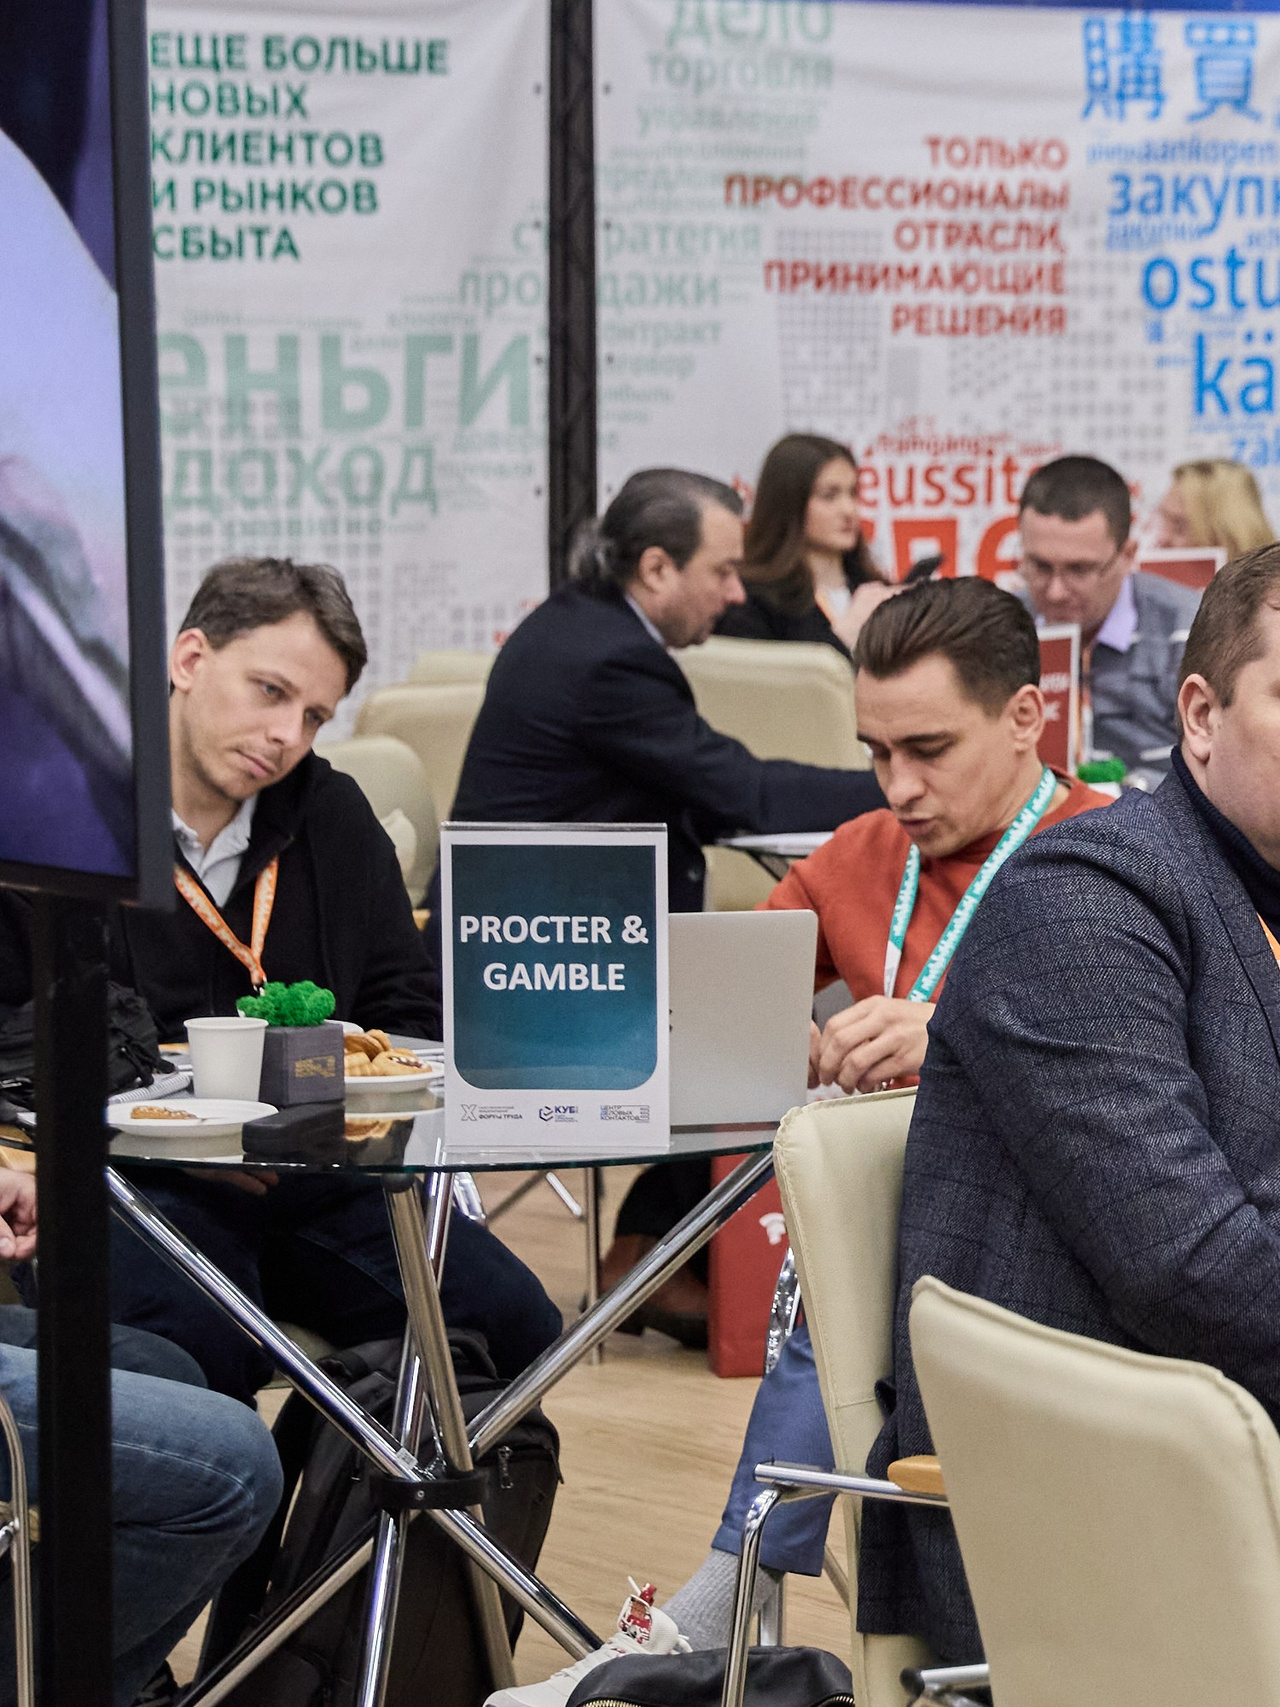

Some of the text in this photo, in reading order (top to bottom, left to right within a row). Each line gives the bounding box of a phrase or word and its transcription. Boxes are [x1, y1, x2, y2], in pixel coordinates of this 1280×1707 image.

[151, 33, 450, 76] ЕЩЕ БОЛЬШЕ
[151, 80, 309, 120] НОВЫХ
[151, 129, 386, 168] КЛИЕНТОВ
[925, 136, 1069, 170] ТОЛЬКО
[151, 179, 380, 215] И РЫНКОВ
[724, 173, 1070, 211] ПРОФЕССИОНАЛЫ
[151, 225, 300, 261] СБЫТА
[513, 222, 763, 262] сратегия
[894, 220, 1068, 256] ОТРАСЛИ,
[764, 259, 1067, 298] ПРИНИМАЮЩИЕ
[892, 304, 1067, 337] РЕШЕНИЯ
[158, 332, 531, 437] еньги
[166, 444, 439, 518] доход
[460, 915, 649, 944] PROCTER &
[483, 962, 626, 991] GAMBLE
